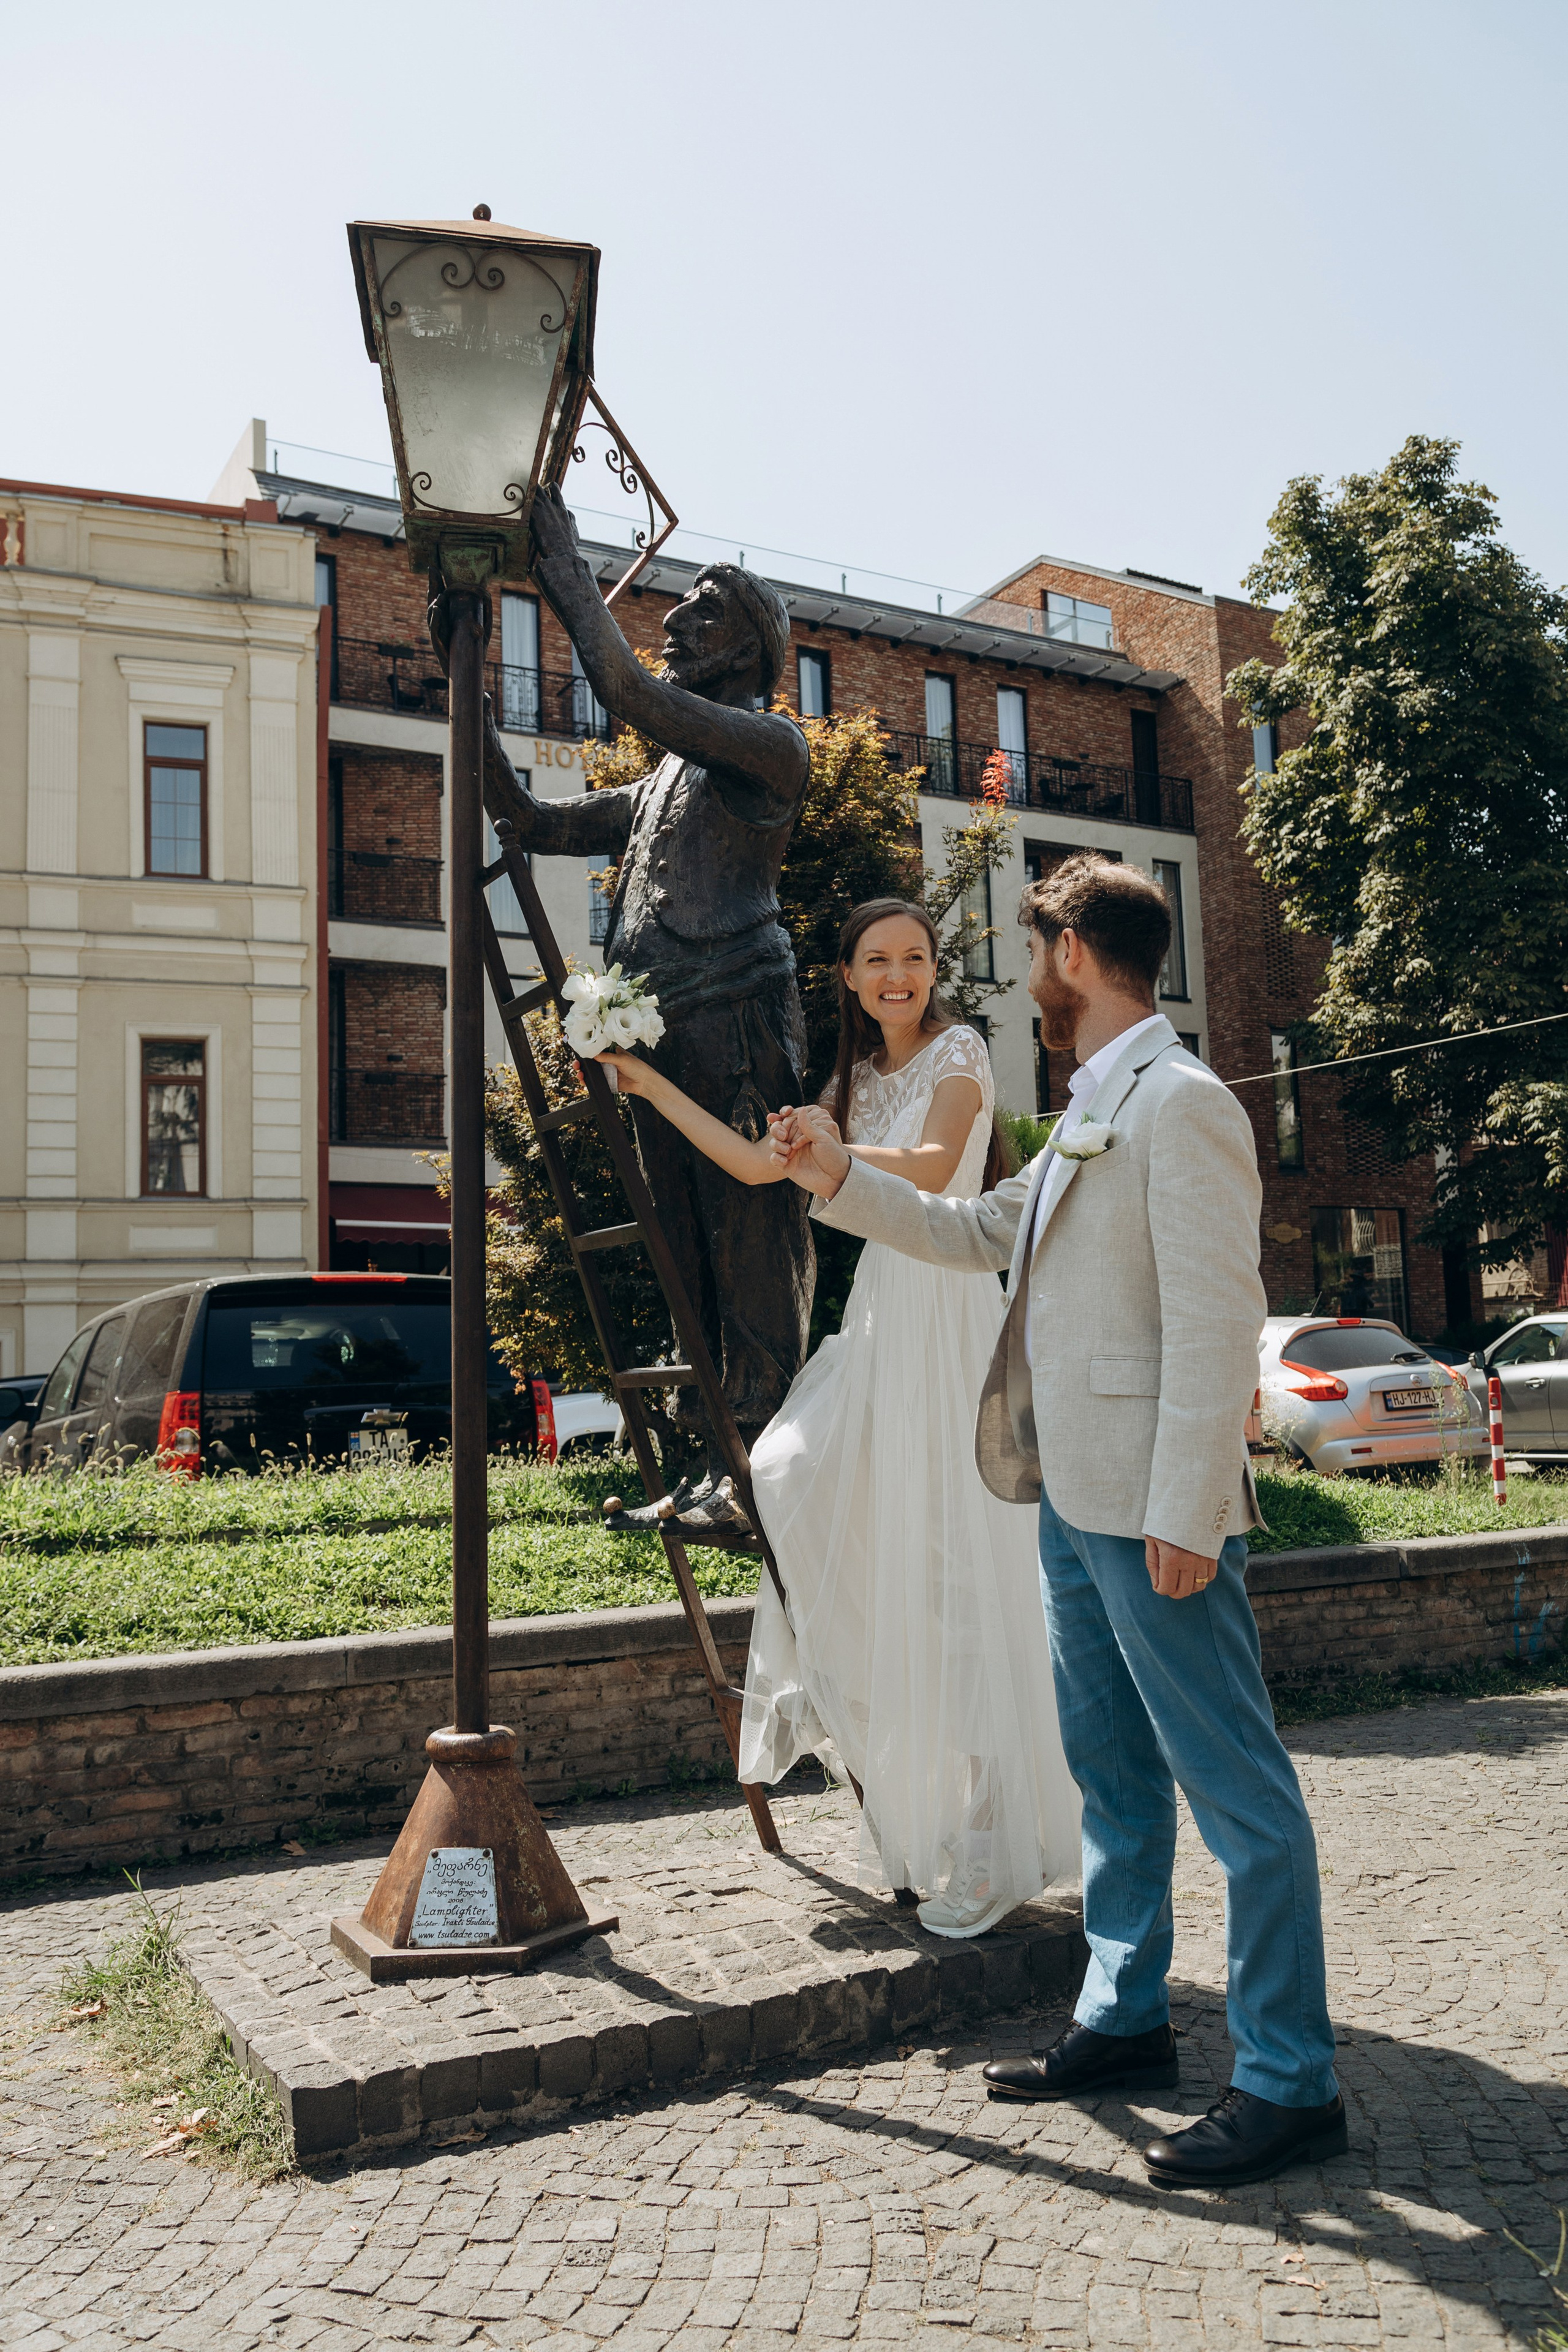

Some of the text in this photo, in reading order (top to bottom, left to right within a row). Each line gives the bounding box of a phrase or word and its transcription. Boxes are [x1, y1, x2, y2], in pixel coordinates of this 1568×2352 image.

[1392, 1391, 1436, 1406] HJ-127-HJ
[369, 1431, 389, 1448] TA
[442, 1917, 464, 1926] Irakli
[466, 1917, 496, 1926] Tsuladze
